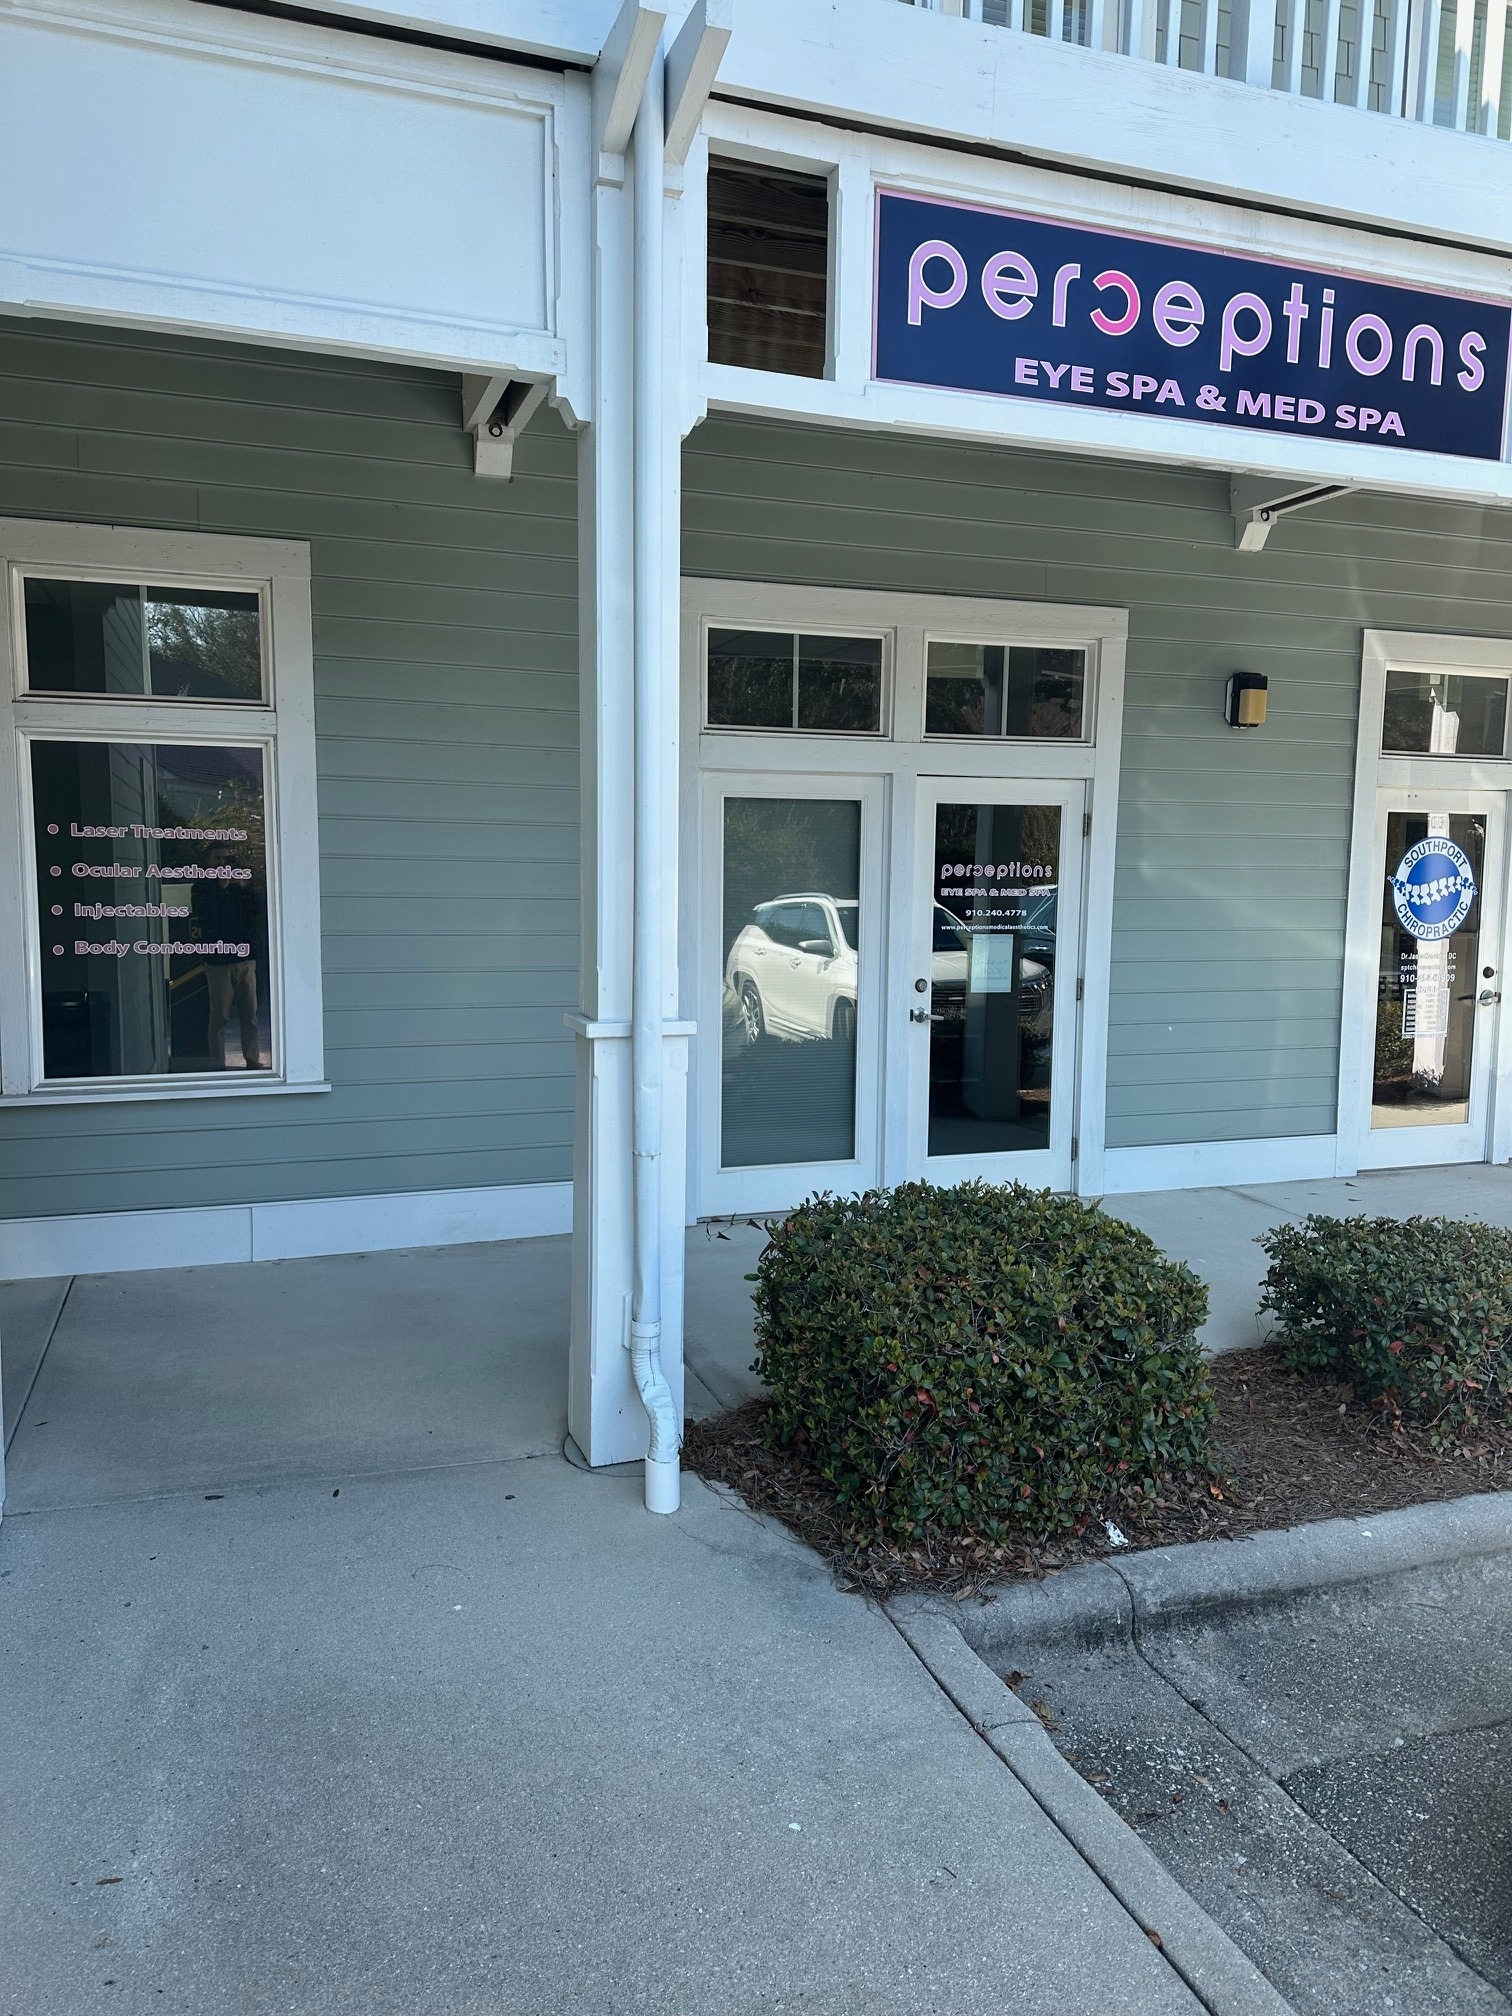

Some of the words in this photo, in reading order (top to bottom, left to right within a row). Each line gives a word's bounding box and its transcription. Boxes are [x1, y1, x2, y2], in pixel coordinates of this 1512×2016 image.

[906, 238, 1488, 393] perceptions
[1012, 355, 1096, 395] EYE
[1104, 370, 1185, 408] SPA
[1195, 383, 1227, 412] &
[1234, 389, 1327, 426] MED
[1333, 407, 1407, 438] SPA
[70, 822, 128, 838] Laser
[130, 824, 248, 841] Treatments
[1404, 840, 1468, 868] SOUTHPORT
[71, 862, 142, 878] Ocular
[146, 864, 252, 880] Aesthetics
[941, 861, 1053, 880] perceptions
[940, 887, 963, 896] EYE
[964, 888, 987, 896] SPA
[988, 888, 999, 897] &
[1000, 888, 1028, 897] MED
[1028, 888, 1051, 897] SPA
[73, 902, 189, 920] Injectables
[965, 909, 1028, 917] 910.240.4778
[1397, 901, 1469, 938] CHIROPRACTIC
[941, 923, 1049, 932] www.perceptionsmedicalaesthetics.com
[74, 940, 130, 957] Body
[133, 939, 250, 957] Contouring
[1448, 952, 1457, 960] DC
